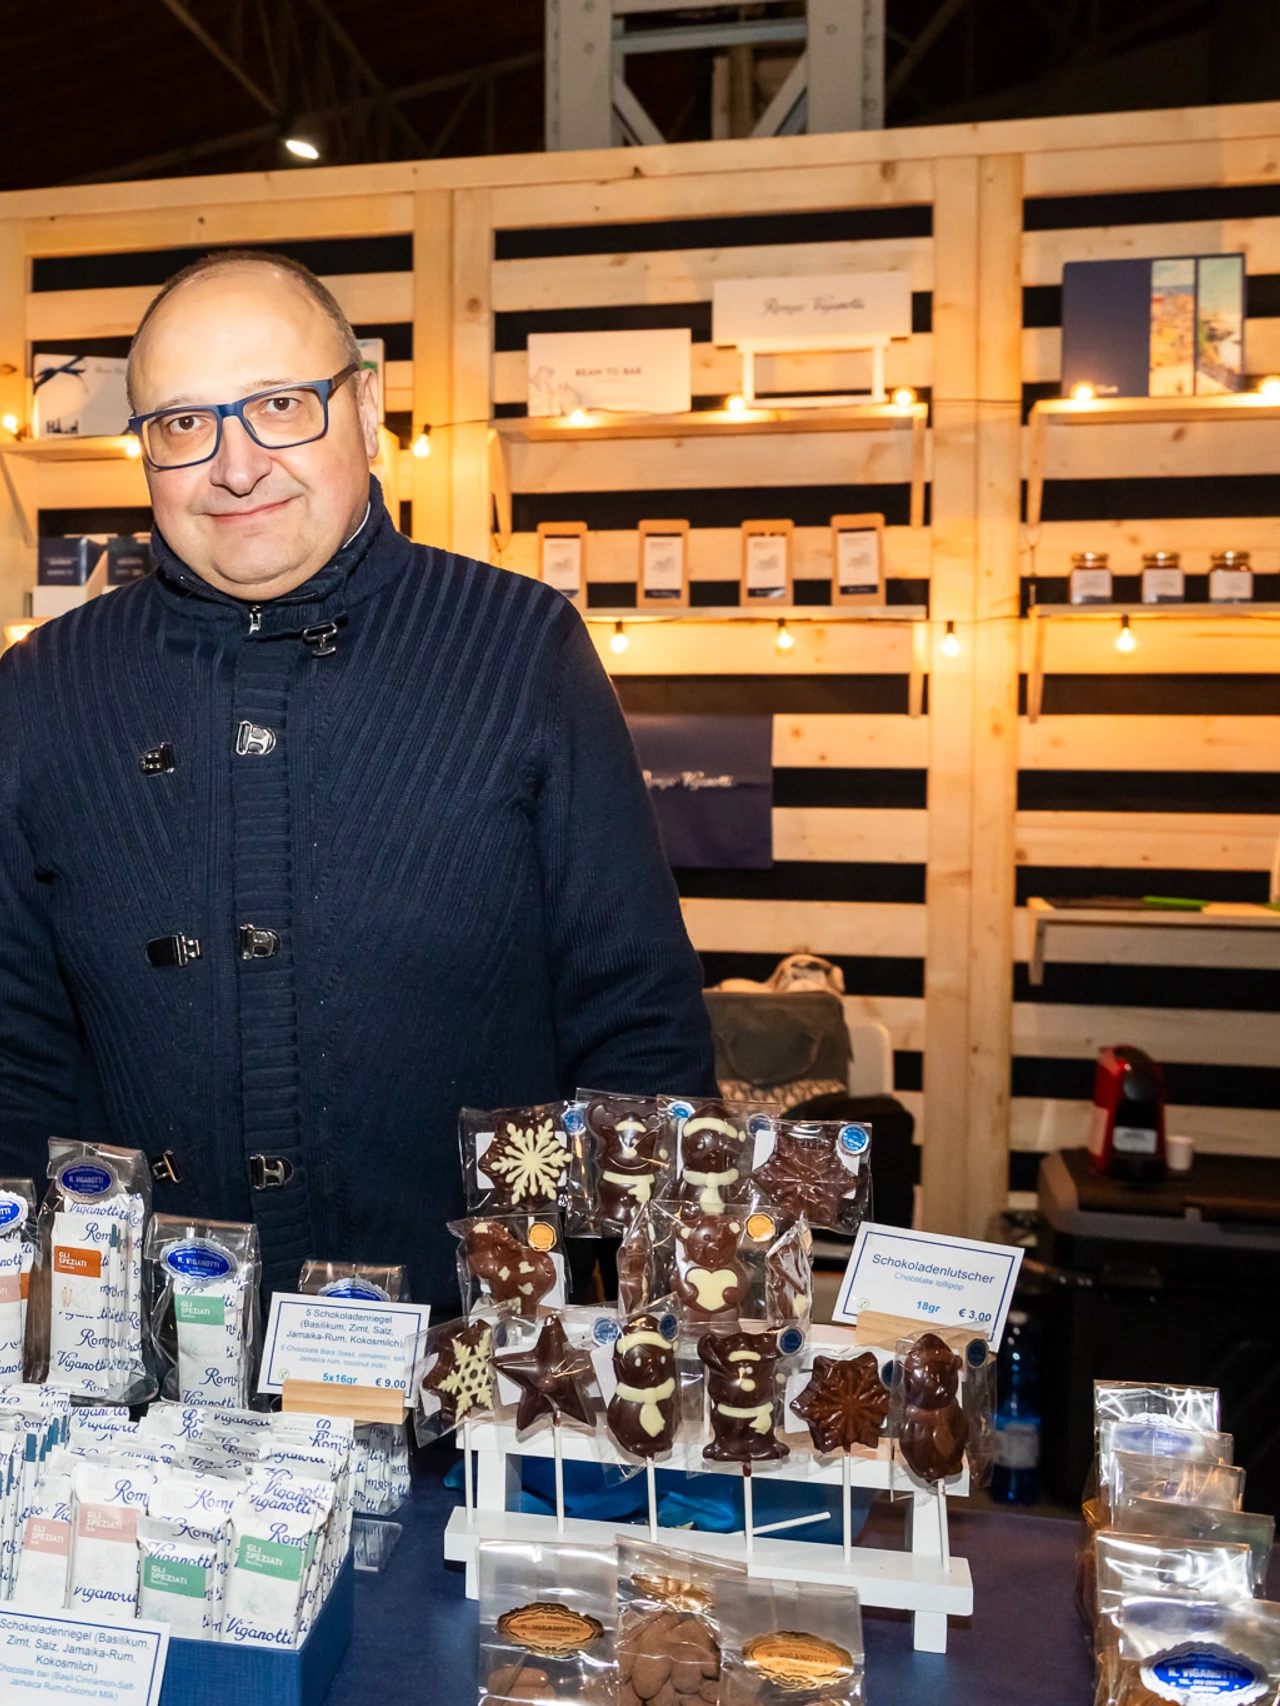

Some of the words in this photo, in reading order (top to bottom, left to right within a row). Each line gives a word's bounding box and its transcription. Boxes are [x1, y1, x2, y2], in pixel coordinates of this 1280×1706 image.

[58, 1251, 70, 1259] GLI
[58, 1257, 88, 1268] SPEZIATI
[872, 1253, 995, 1284] Schokoladenlutscher
[894, 1272, 934, 1286] Chocolate
[935, 1279, 964, 1292] lollipop
[180, 1307, 210, 1316] SPEZIATI
[306, 1308, 311, 1317] 5
[314, 1310, 393, 1324] Schokoladenriegel
[916, 1300, 941, 1314] 18gr
[958, 1308, 966, 1318] €
[300, 1319, 346, 1332] (Basilikum,
[348, 1323, 370, 1334] Zimt,
[286, 1330, 346, 1343] Jamaika-Rum,
[286, 1345, 319, 1354] Chocolate
[322, 1373, 358, 1385] 5x16gr
[375, 1377, 382, 1387] €
[32, 1524, 46, 1533] GLI
[31, 1531, 64, 1544] SPEZIATI
[247, 1543, 262, 1553] GLI
[245, 1551, 284, 1567] SPEZIATI
[151, 1564, 167, 1574] GLI
[151, 1571, 188, 1585] SPEZIATI
[0, 1618, 93, 1641] Schokoladenriegel
[94, 1632, 151, 1650] (Basilikum,
[226, 1615, 294, 1645] Viganotti
[6, 1635, 31, 1648] Zimt,
[35, 1639, 59, 1653] Salz,
[62, 1643, 136, 1663] Jamaika-Rum,
[36, 1654, 98, 1674] Kokosmilch)
[36, 1669, 50, 1678] bar
[9, 1678, 43, 1690] Jamaica
